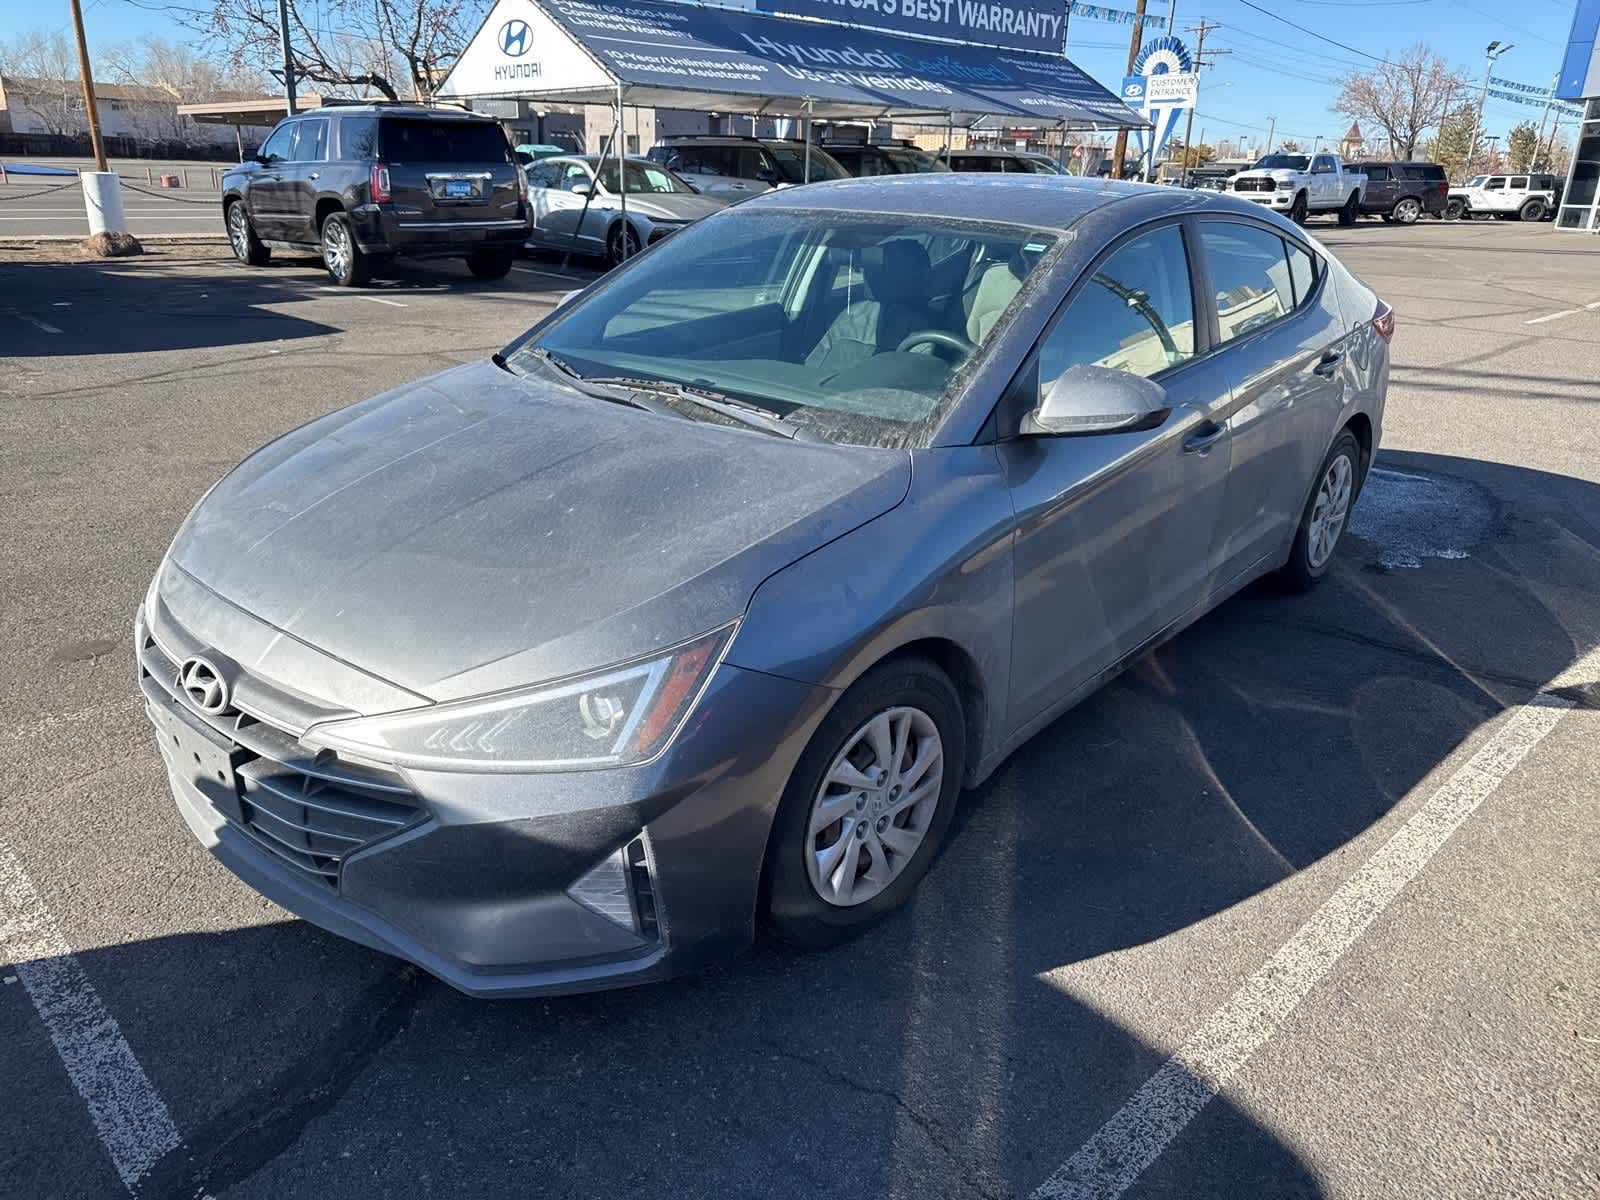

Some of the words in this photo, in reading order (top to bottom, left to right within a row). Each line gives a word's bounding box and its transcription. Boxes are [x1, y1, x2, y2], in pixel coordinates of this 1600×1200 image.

[558, 7, 672, 28] Comprehensive
[568, 16, 629, 32] Limited
[626, 23, 693, 40] Warranty
[902, 0, 953, 24] BEST
[958, 0, 1062, 39] WARRANTY
[731, 62, 768, 73] Miles
[740, 32, 903, 69] Hyundai
[890, 51, 1013, 82] Certified
[494, 62, 542, 80] HYUNDAI
[615, 59, 689, 75] Roadside
[687, 67, 762, 81] Assistance
[775, 62, 851, 85] Used
[848, 72, 953, 95] Vehicles
[1150, 87, 1192, 97] ENTRANCE
[1151, 78, 1194, 87] CUSTOMER
